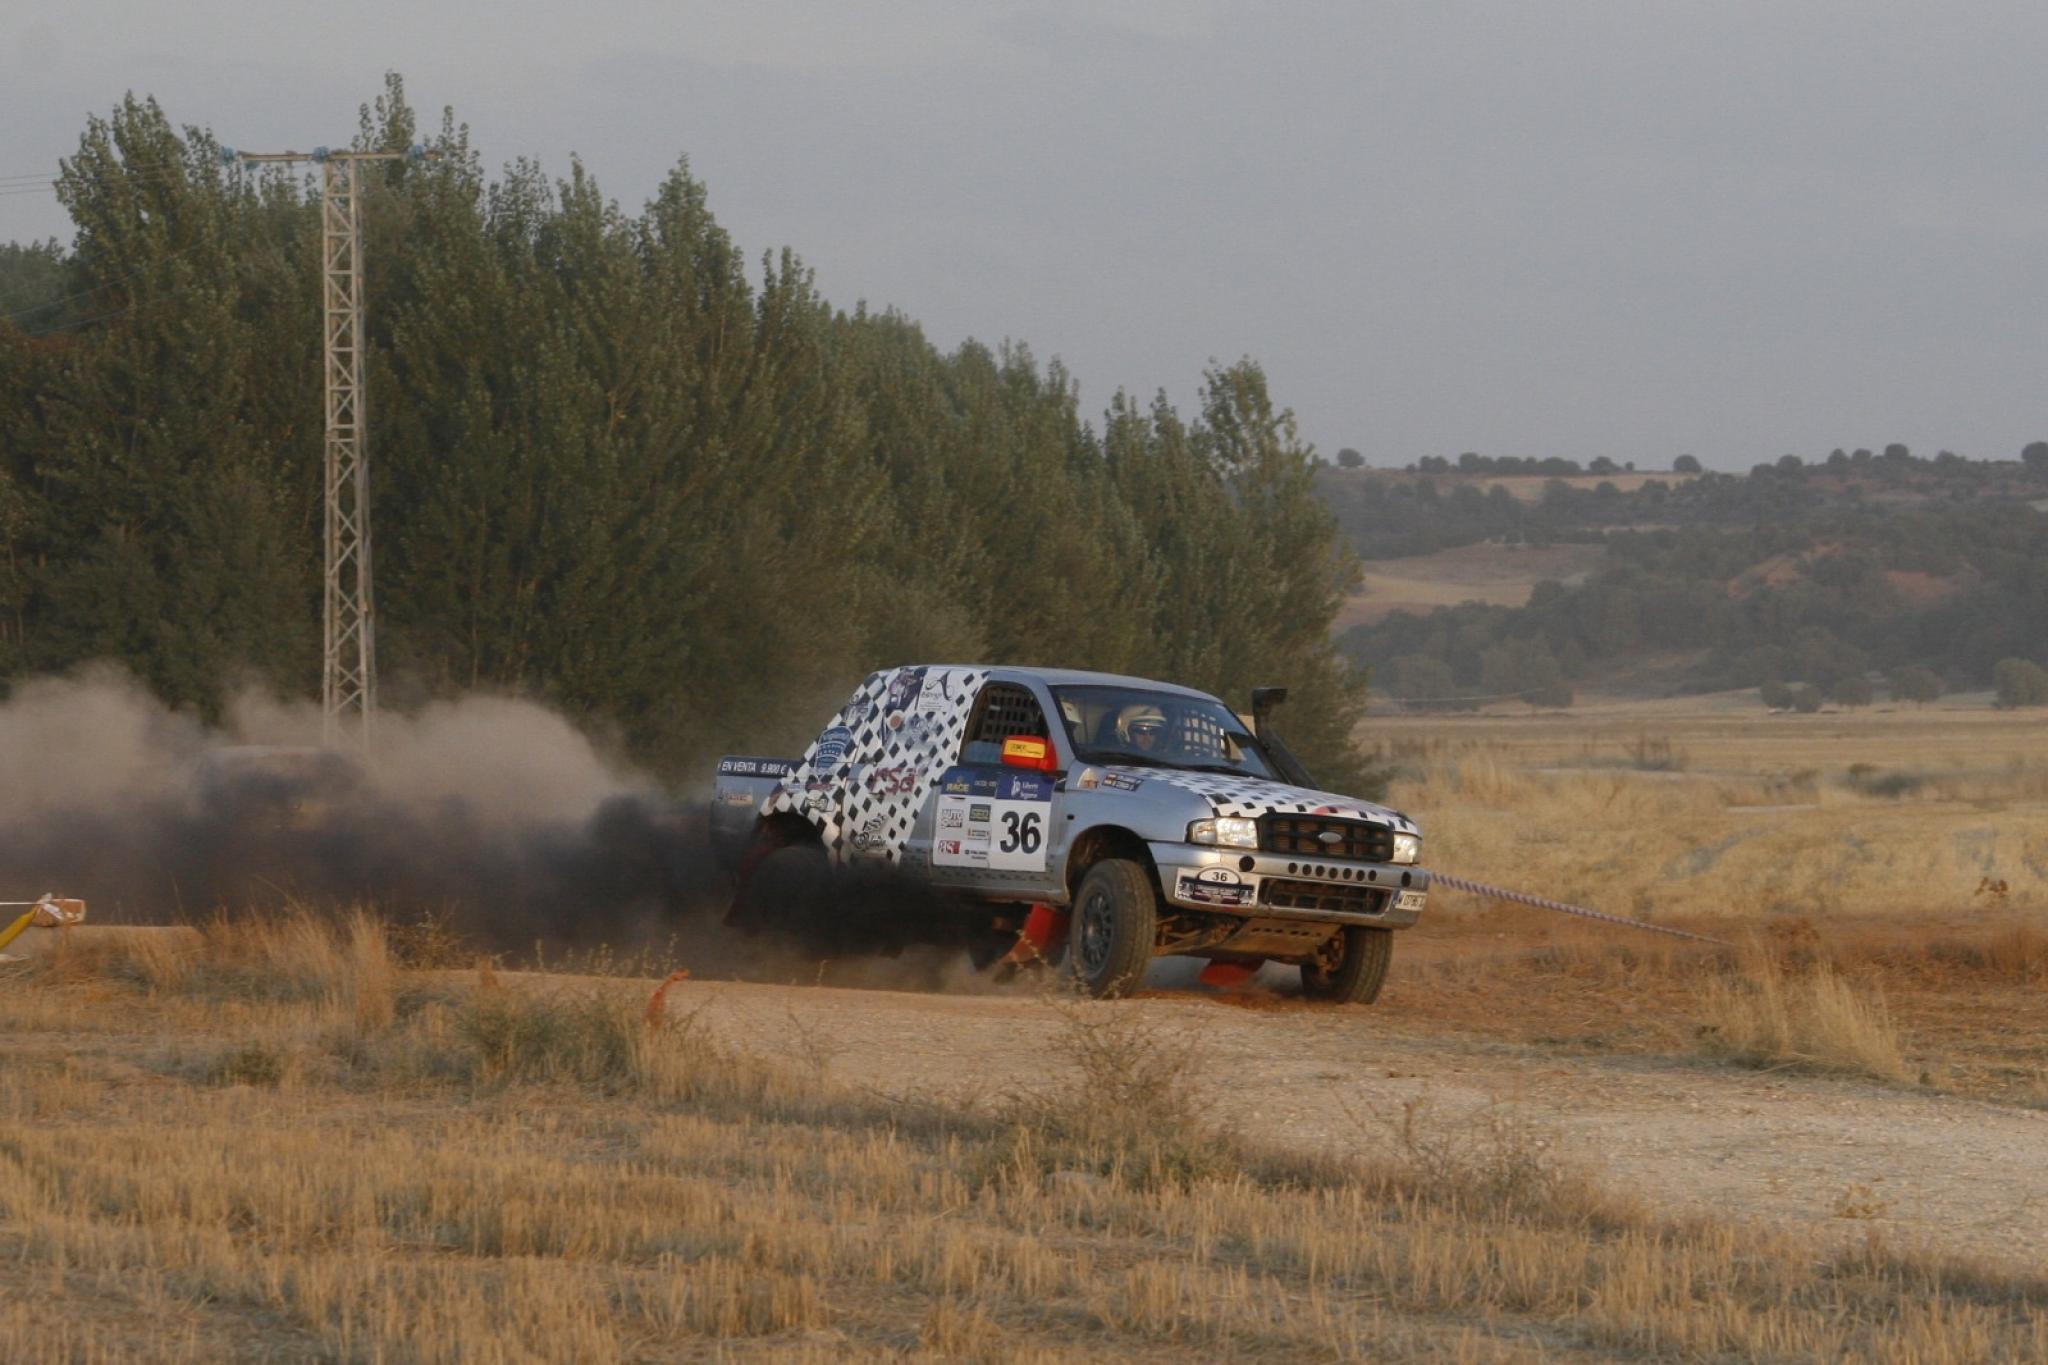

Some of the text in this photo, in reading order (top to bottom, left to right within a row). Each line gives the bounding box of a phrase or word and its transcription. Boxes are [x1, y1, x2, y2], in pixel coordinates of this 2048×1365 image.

[721, 761, 731, 771] EN
[734, 761, 756, 773] VENTA
[946, 783, 970, 792] RACE
[1000, 811, 1041, 854] 36
[1211, 871, 1228, 882] 36
